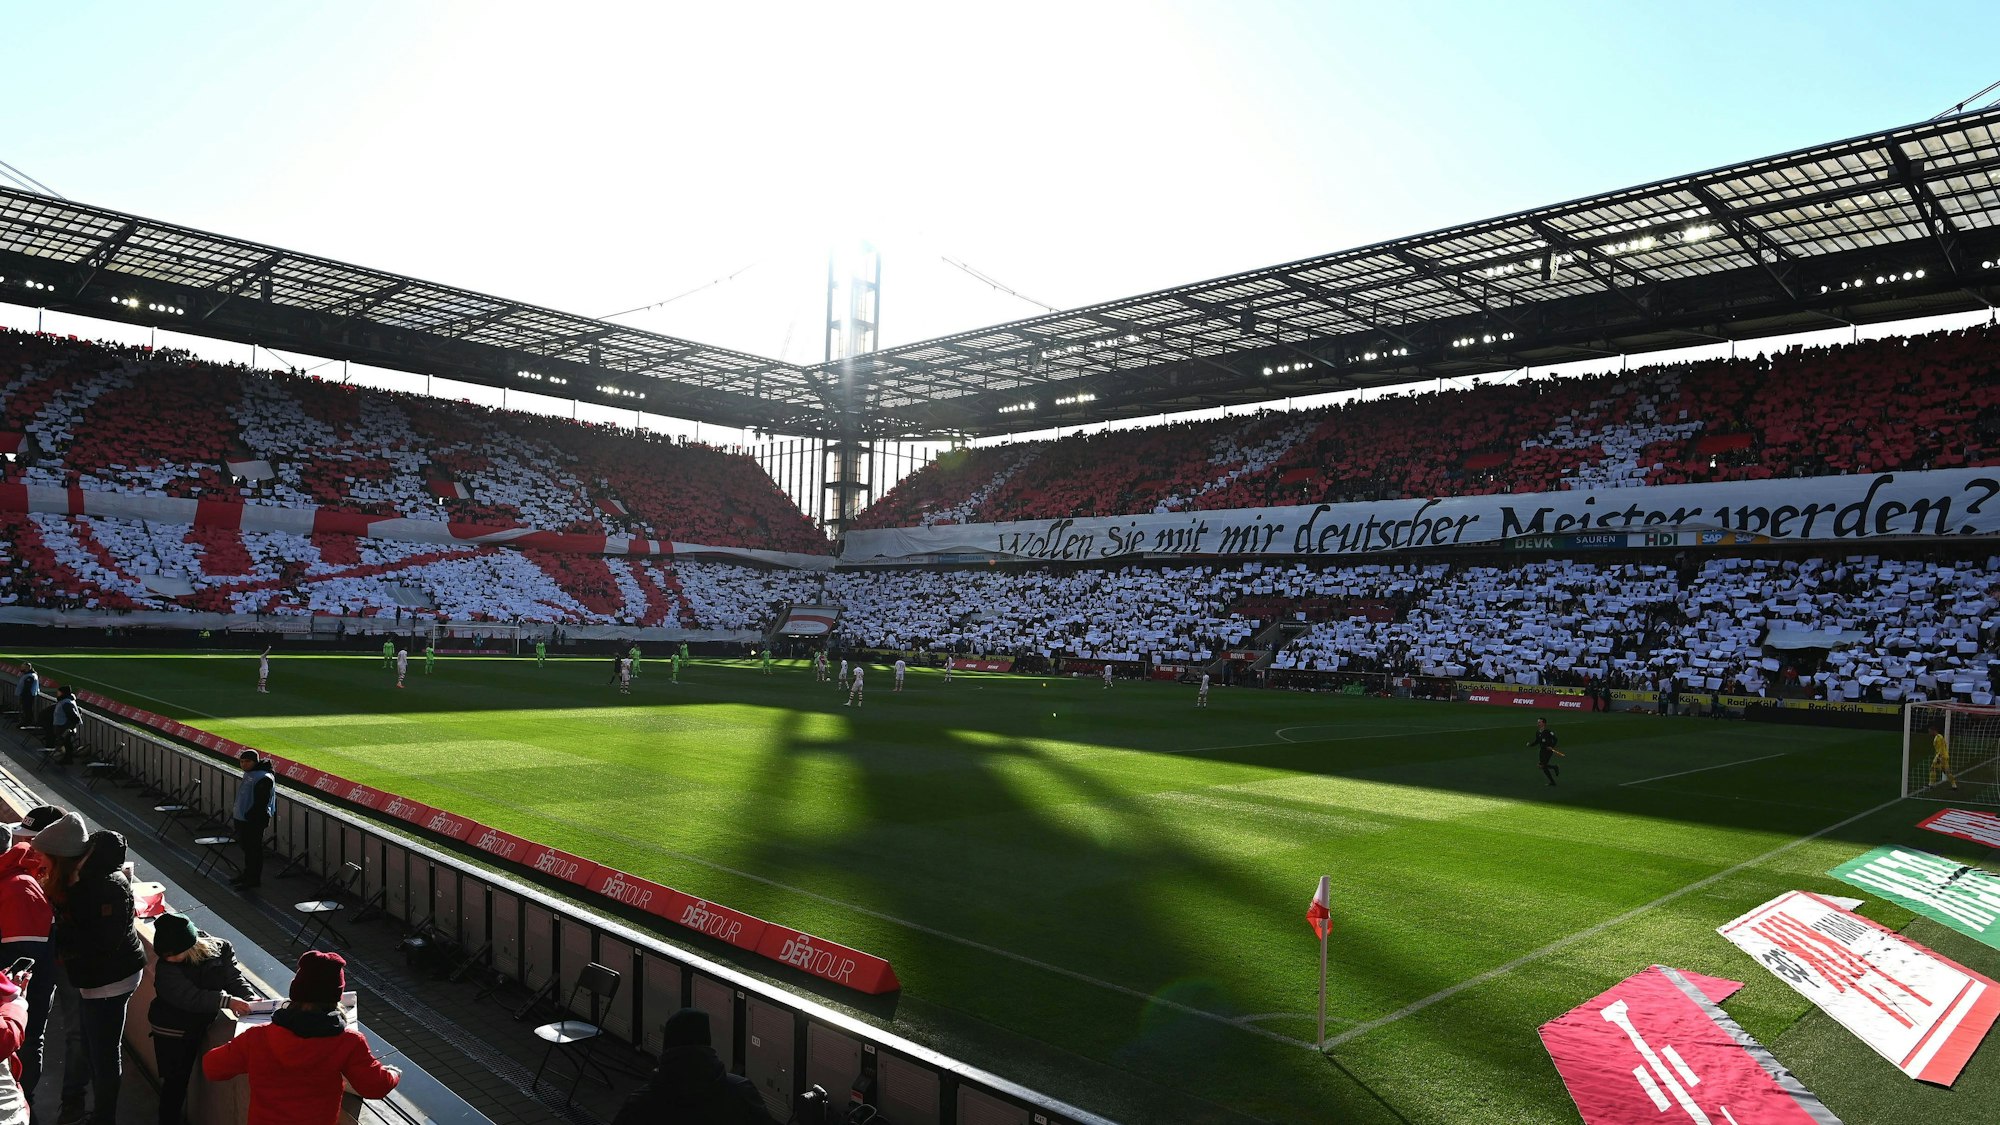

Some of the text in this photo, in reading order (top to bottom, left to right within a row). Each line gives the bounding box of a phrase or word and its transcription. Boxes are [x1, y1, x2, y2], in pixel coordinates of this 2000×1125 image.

[998, 474, 2000, 560] Wollen Sie mit mir deutscher Meister werden?
[1514, 538, 1553, 549] DEVK
[1575, 535, 1616, 544] SAUREN
[1645, 533, 1678, 546] HDI
[1702, 534, 1722, 543] SAP
[1735, 532, 1756, 542] SAP
[1230, 652, 1246, 660] REWE
[1840, 703, 1864, 713] Köln
[346, 785, 376, 806] DERTOUR
[385, 798, 416, 821] DERTOUR
[427, 812, 463, 838] DERTOUR
[476, 830, 516, 859] DERTOUR
[533, 848, 579, 881] DERTOUR
[601, 873, 653, 909] DERTOUR
[680, 901, 743, 943] DERTOUR
[779, 935, 856, 984] DERTOUR
